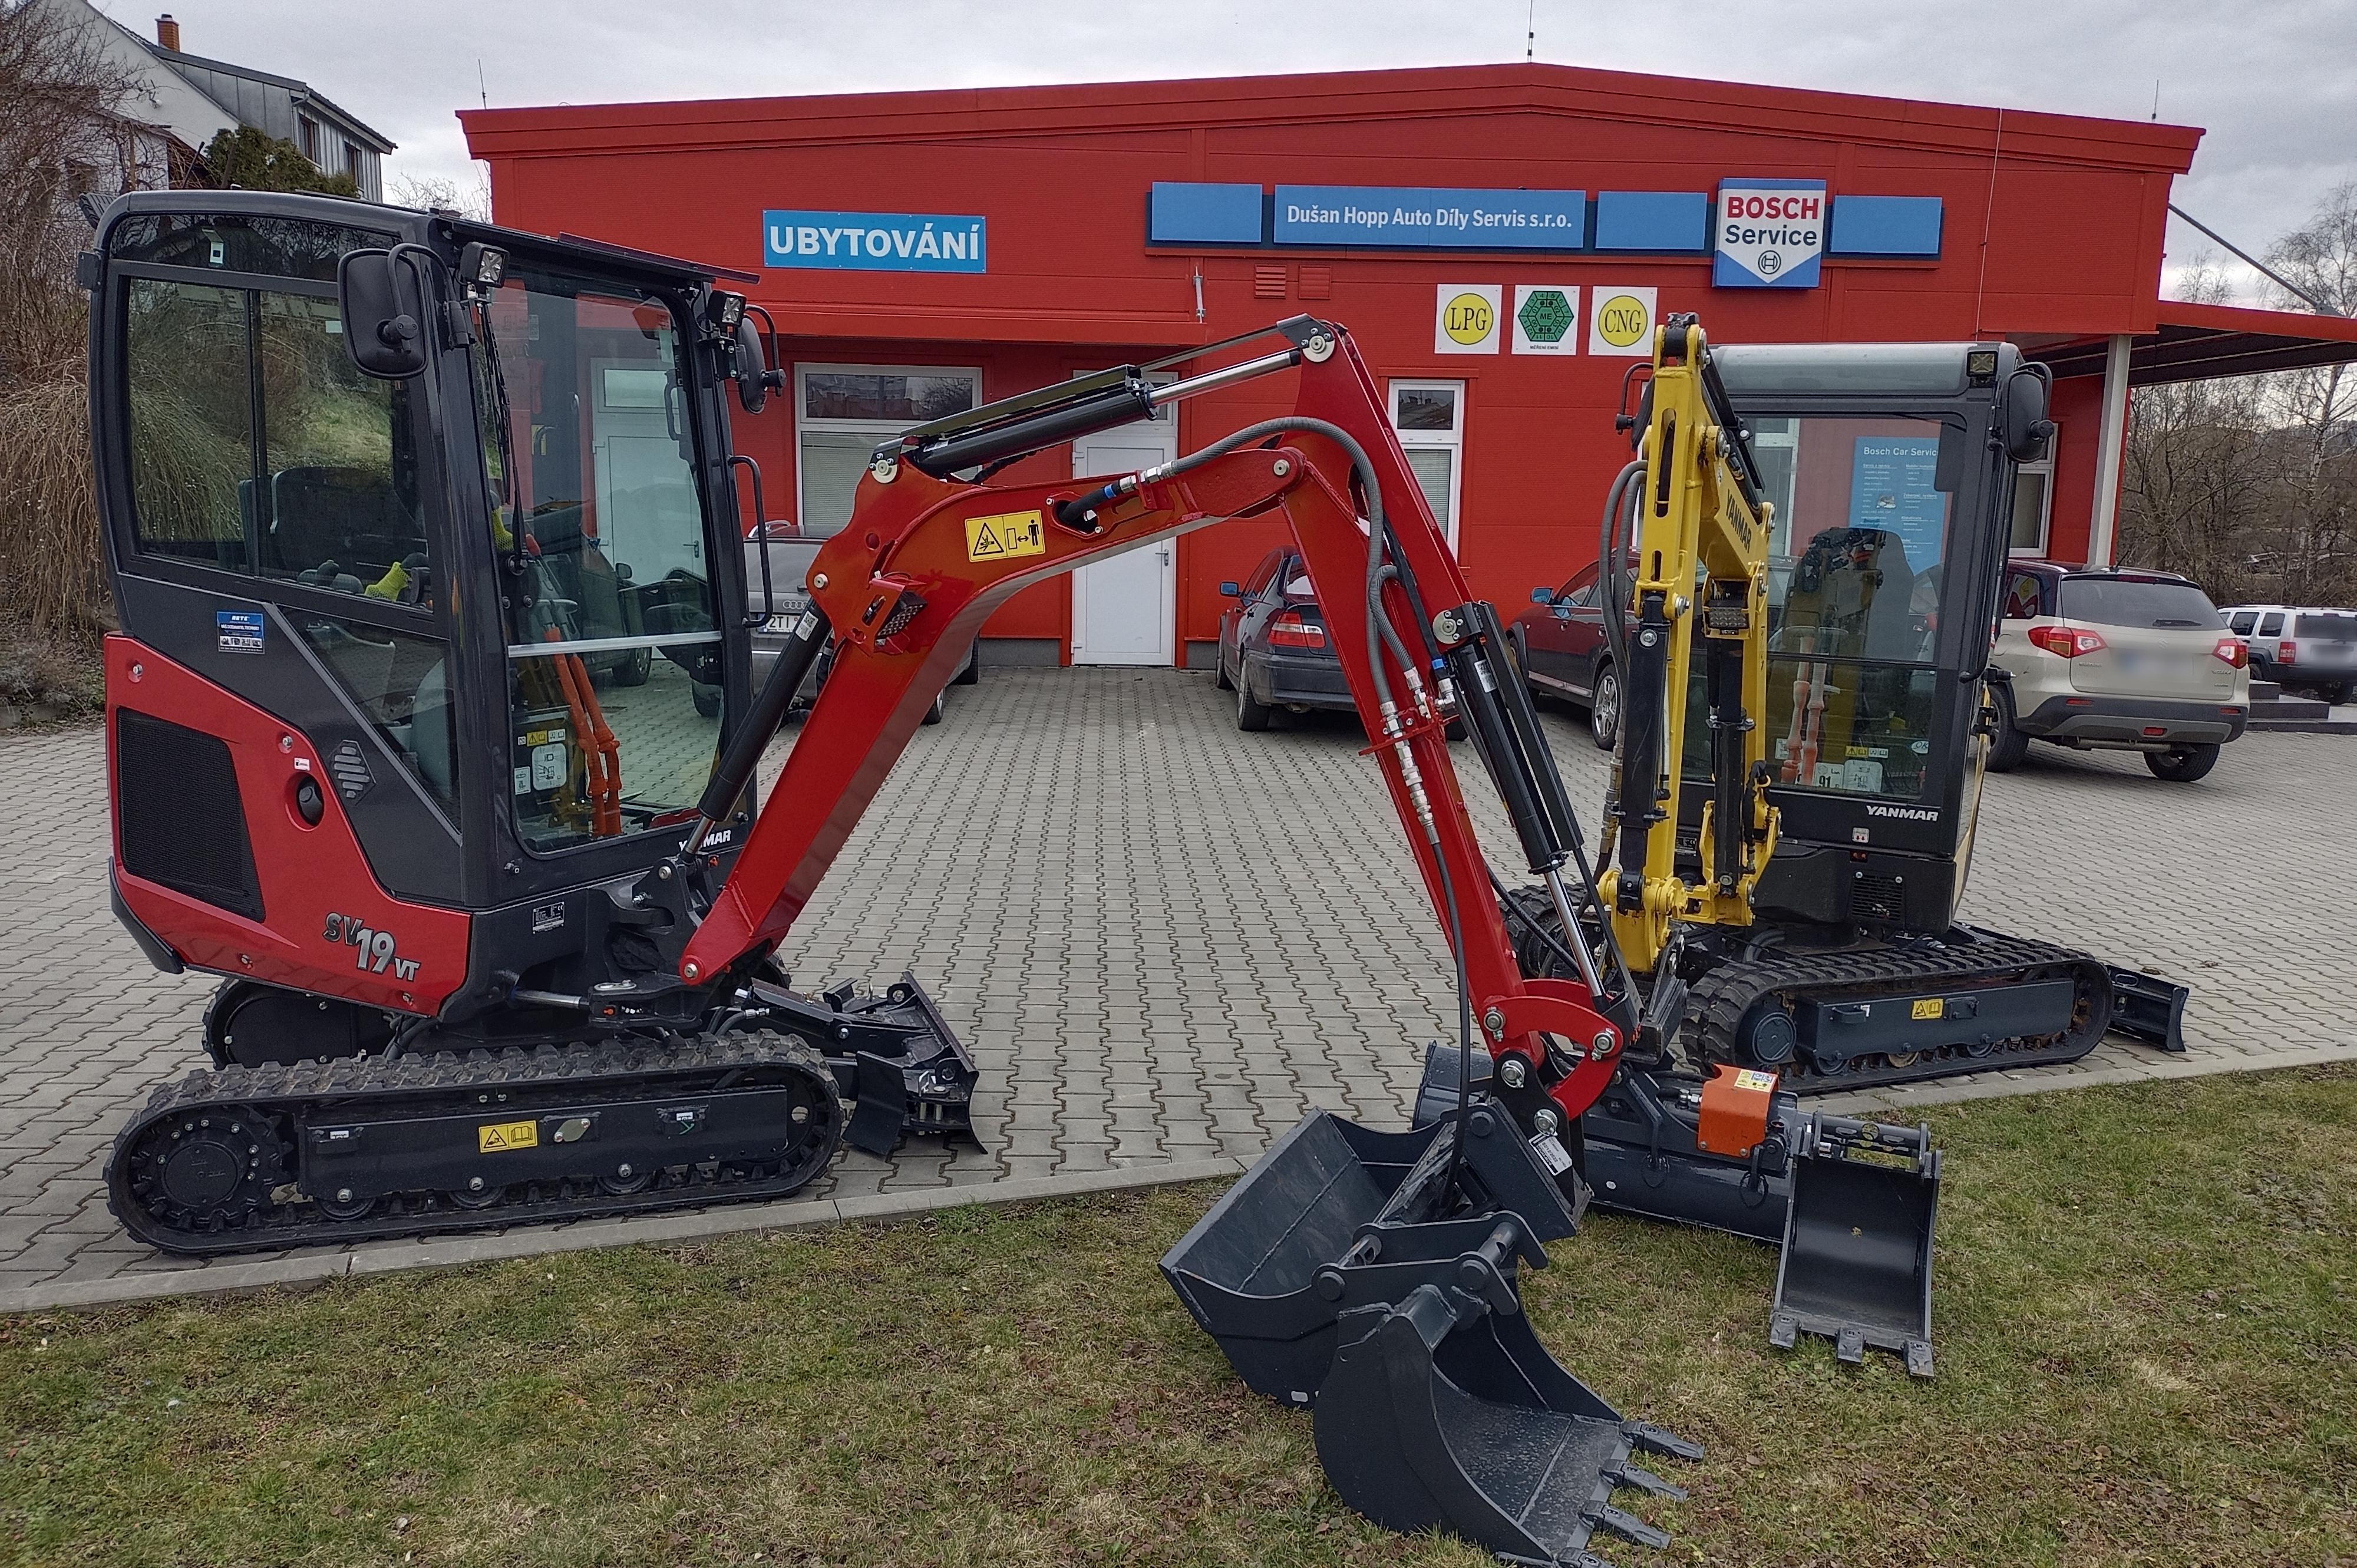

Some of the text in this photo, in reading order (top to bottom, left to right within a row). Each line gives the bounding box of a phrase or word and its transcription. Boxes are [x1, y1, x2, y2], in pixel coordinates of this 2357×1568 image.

[1288, 204, 1572, 230] Dušan Hopp Auto Díly Servis s.r.o.
[1727, 196, 1819, 219] BOSCH
[770, 223, 980, 260] UBYTOVÁNÍ
[1725, 225, 1817, 246] Service
[1450, 308, 1487, 331] LPG
[1605, 309, 1641, 333] CNG
[1864, 447, 1890, 455] Bosch
[1910, 448, 1938, 456] Servic
[1726, 488, 1752, 553] YANMAR
[1819, 775, 1831, 788] 91
[1866, 805, 1939, 821] YANMAR
[678, 830, 731, 852] YMAR
